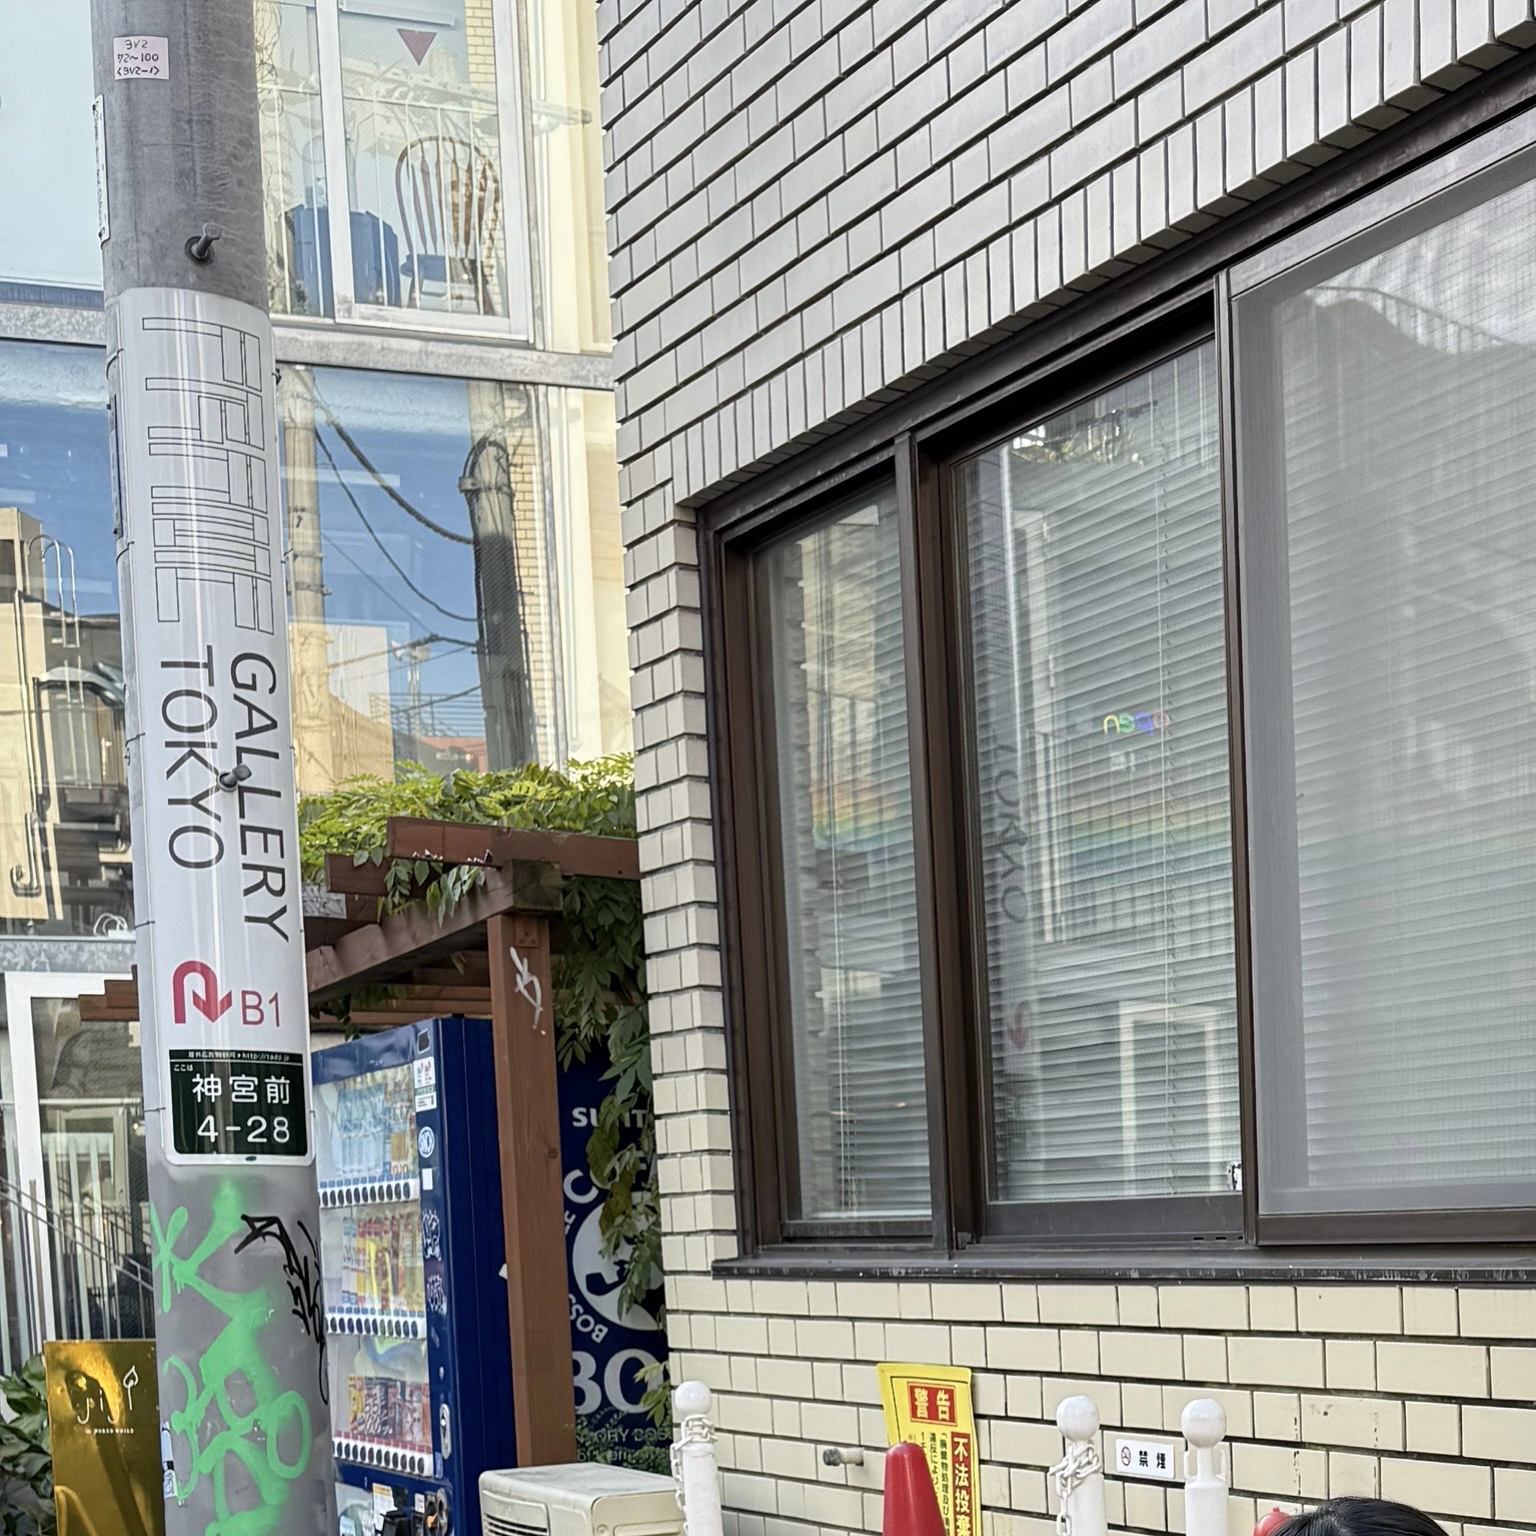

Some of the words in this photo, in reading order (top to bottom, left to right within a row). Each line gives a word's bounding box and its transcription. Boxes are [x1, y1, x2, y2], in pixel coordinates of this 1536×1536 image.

[160, 644, 226, 870] TOKYO
[230, 652, 289, 944] GALLERY
[240, 989, 282, 1028] B1
[174, 1064, 194, 1072] ここは
[192, 1073, 291, 1105] 神宮前
[197, 1114, 290, 1143] 4-28
[914, 1387, 951, 1421] 警告
[1139, 1450, 1166, 1469] 禁煙
